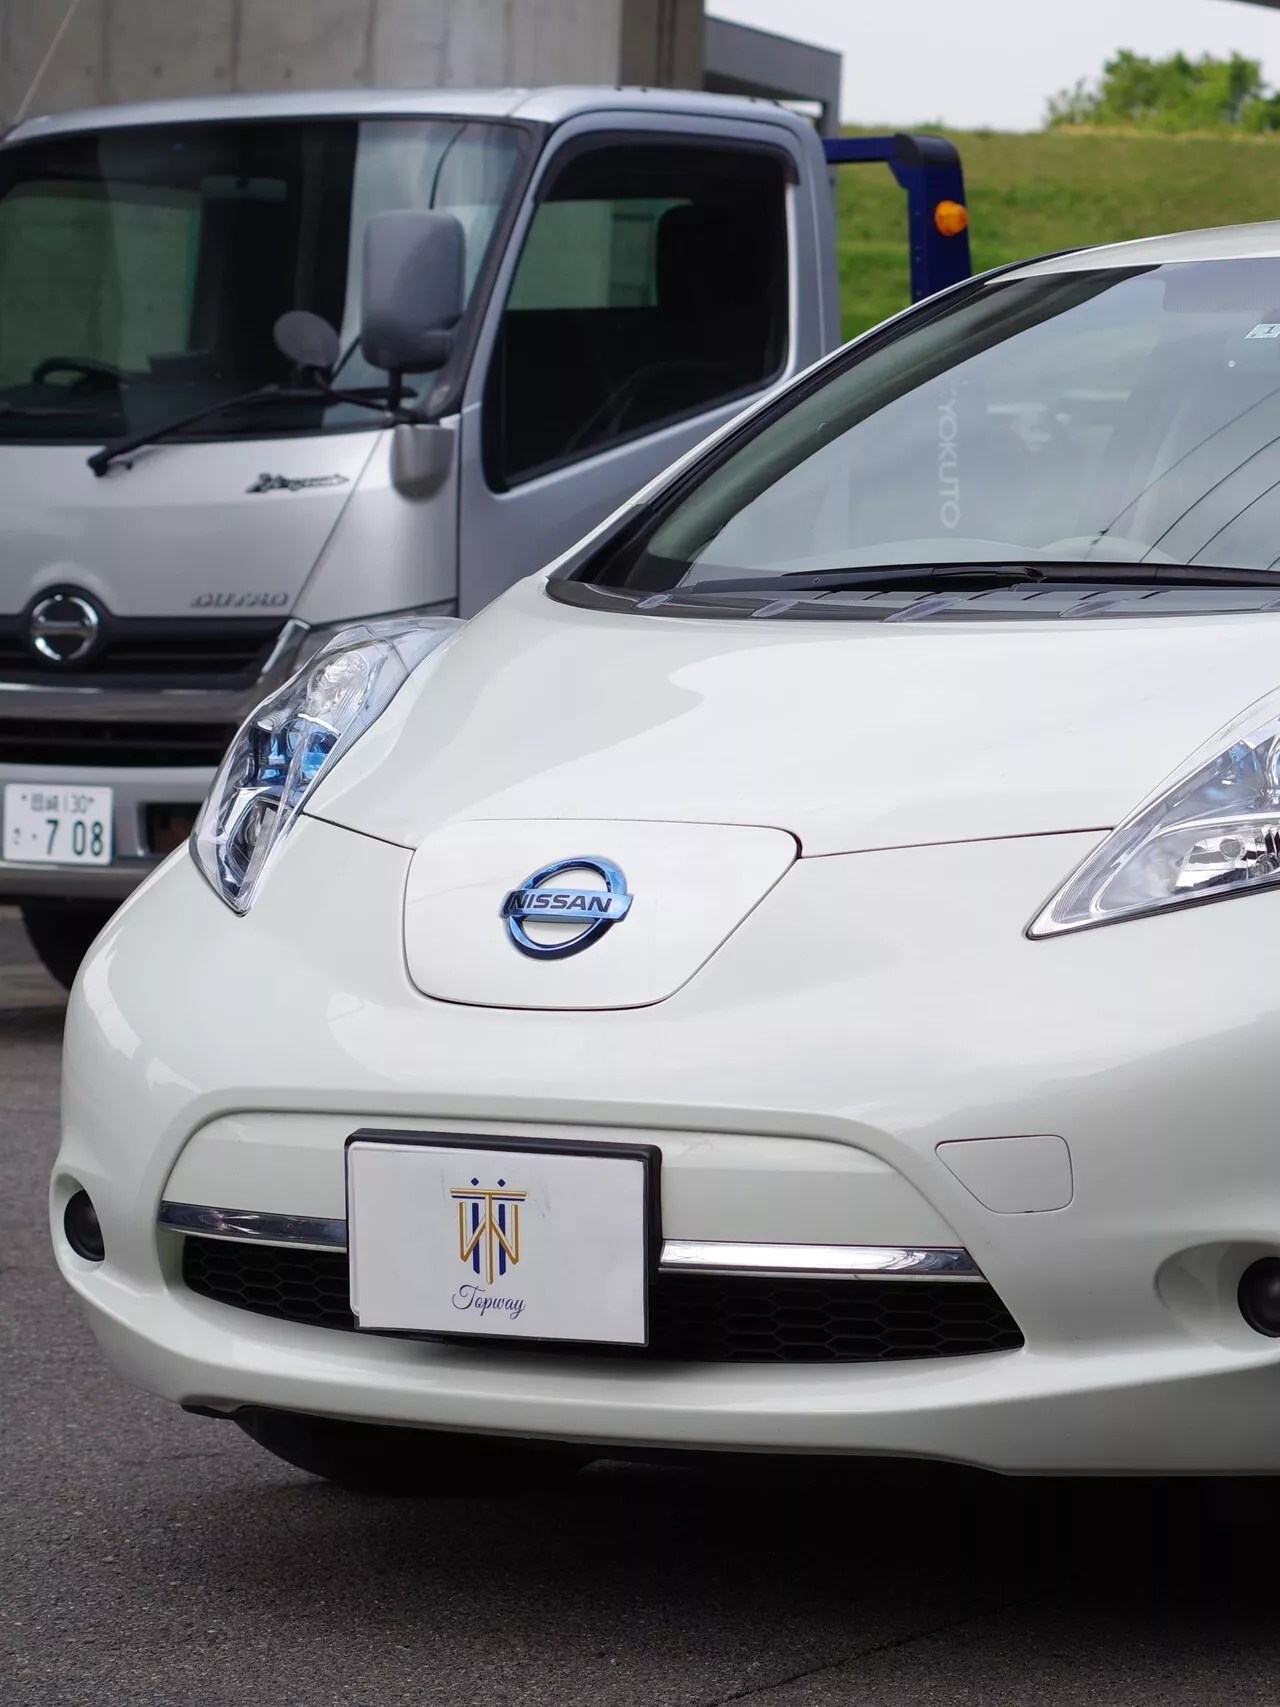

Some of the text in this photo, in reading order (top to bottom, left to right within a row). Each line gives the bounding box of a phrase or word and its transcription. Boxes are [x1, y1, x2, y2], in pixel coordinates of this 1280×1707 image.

[937, 387, 960, 529] YOKUTO
[510, 893, 612, 913] NISSAN
[452, 1284, 526, 1320] Topway
